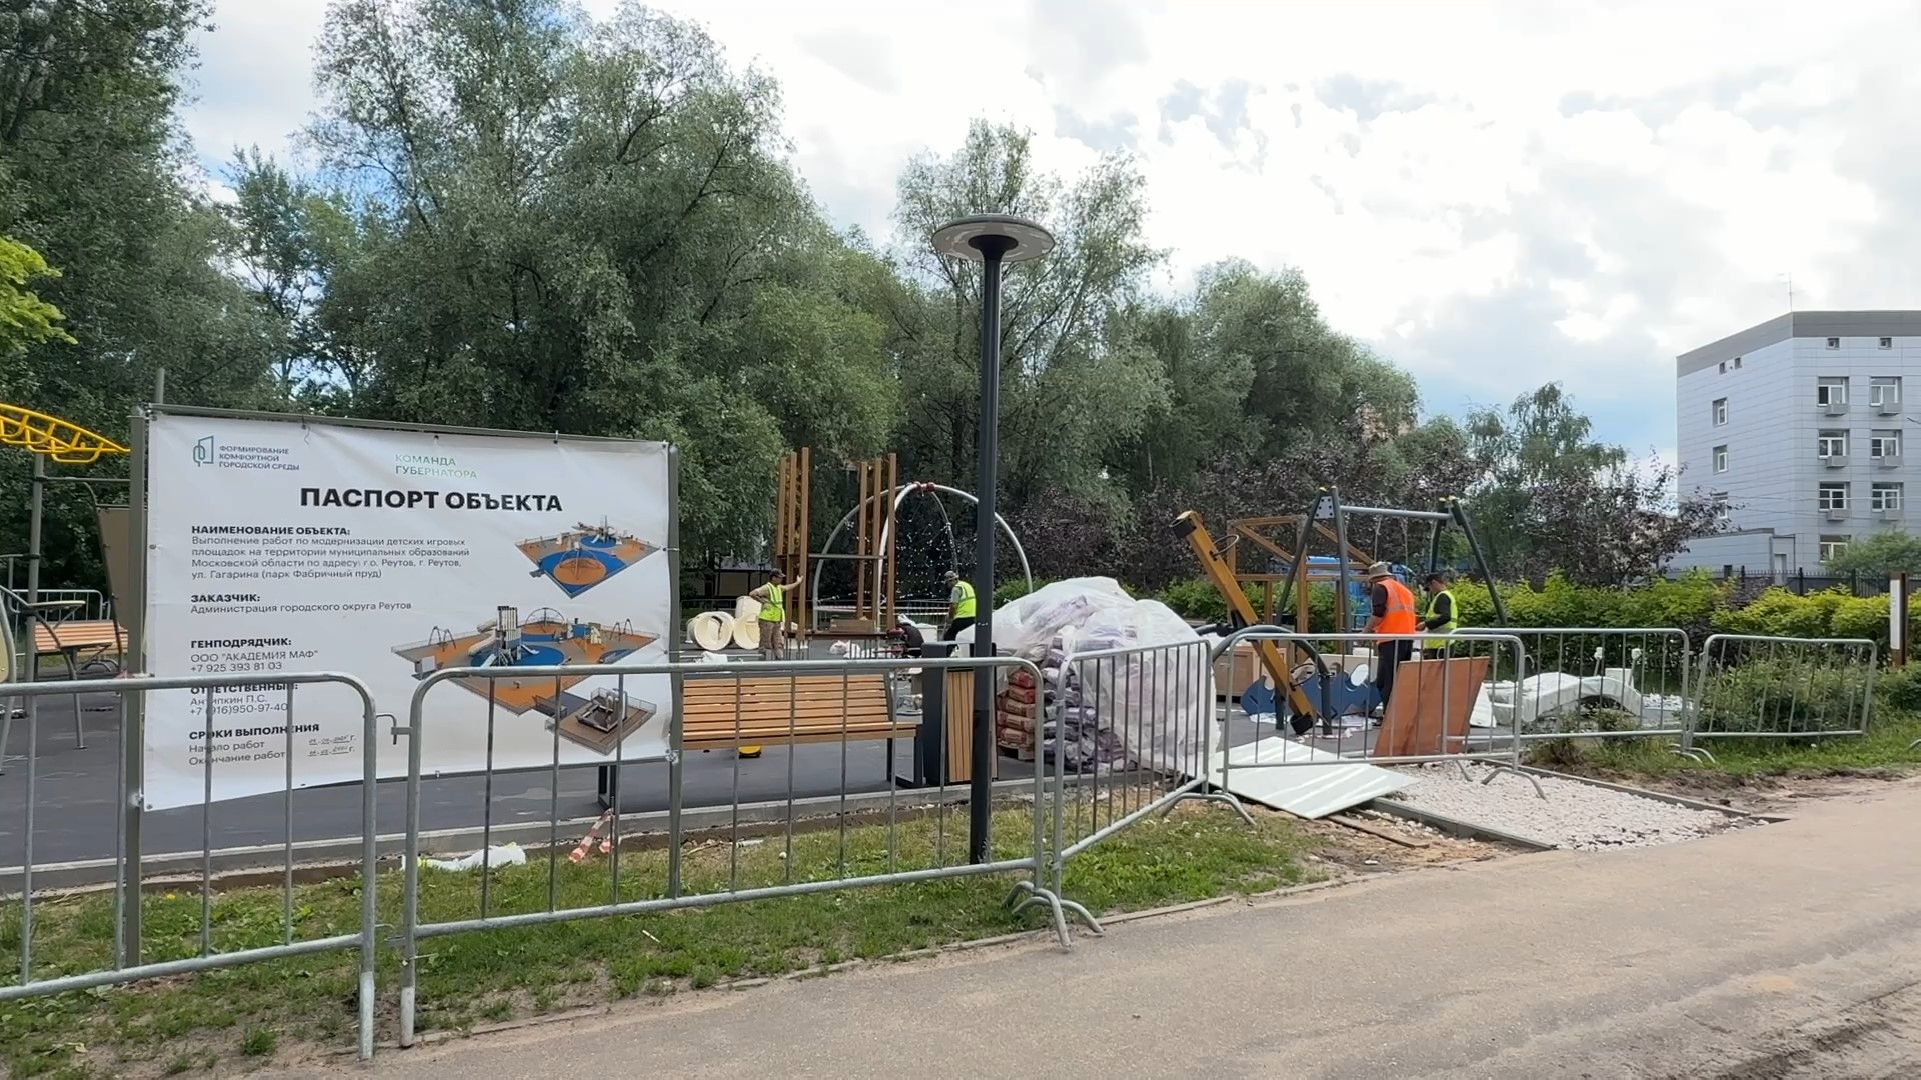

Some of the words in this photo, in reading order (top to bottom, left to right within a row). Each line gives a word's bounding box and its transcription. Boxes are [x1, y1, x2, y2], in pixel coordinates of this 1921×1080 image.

[219, 445, 289, 454] ФОРМИРОВАНИЕ
[219, 453, 279, 461] КОМФОРТНОЙ
[395, 454, 456, 466] КОМАНДА
[219, 460, 270, 470] ГОРОДСКОЙ
[395, 465, 478, 479] ГУБЕРНАТОРА
[301, 487, 439, 509] ПАСПОРТ
[445, 491, 563, 512] ОБЪЕКТА
[192, 526, 294, 535] НАИМЕНОВАНИЕ
[296, 527, 350, 535] ОБЪЕКТА:
[192, 536, 259, 544] Выполнение
[262, 536, 292, 545] работ
[192, 549, 246, 557] площадок
[264, 549, 326, 557] территории
[329, 549, 406, 557] муниципальных
[408, 546, 470, 556] образований
[192, 558, 258, 568] Московской
[261, 558, 304, 567] области
[381, 559, 416, 568] Реутов,
[428, 559, 462, 568] Реутов,
[192, 571, 206, 580] ул.
[210, 569, 259, 579] Гагарина
[261, 570, 290, 580] (парк
[292, 569, 352, 579] Фабричный
[355, 569, 382, 579] пруд)
[190, 594, 261, 603] ЗАКАЗЧИК:
[190, 604, 277, 614] Администрация
[280, 602, 340, 613] городского
[342, 602, 376, 611] округа
[378, 601, 412, 611] Реутов
[190, 638, 292, 648] ГЕНПОДРЯДЧИК:
[190, 653, 219, 663] ООО
[221, 651, 286, 662] "АКАДЕМИЯ
[289, 650, 319, 659] МАФ"
[190, 663, 203, 672] +7
[206, 661, 226, 672] 925
[230, 661, 250, 671] 393
[253, 661, 265, 670] 81
[268, 661, 282, 670] 03
[191, 683, 299, 694] ОТЕТСТВЕННЫ:
[190, 706, 202, 715] +7
[189, 743, 230, 753] Наало
[233, 740, 265, 751] работ
[189, 755, 251, 765] Окнчание
[253, 750, 285, 761] работ
